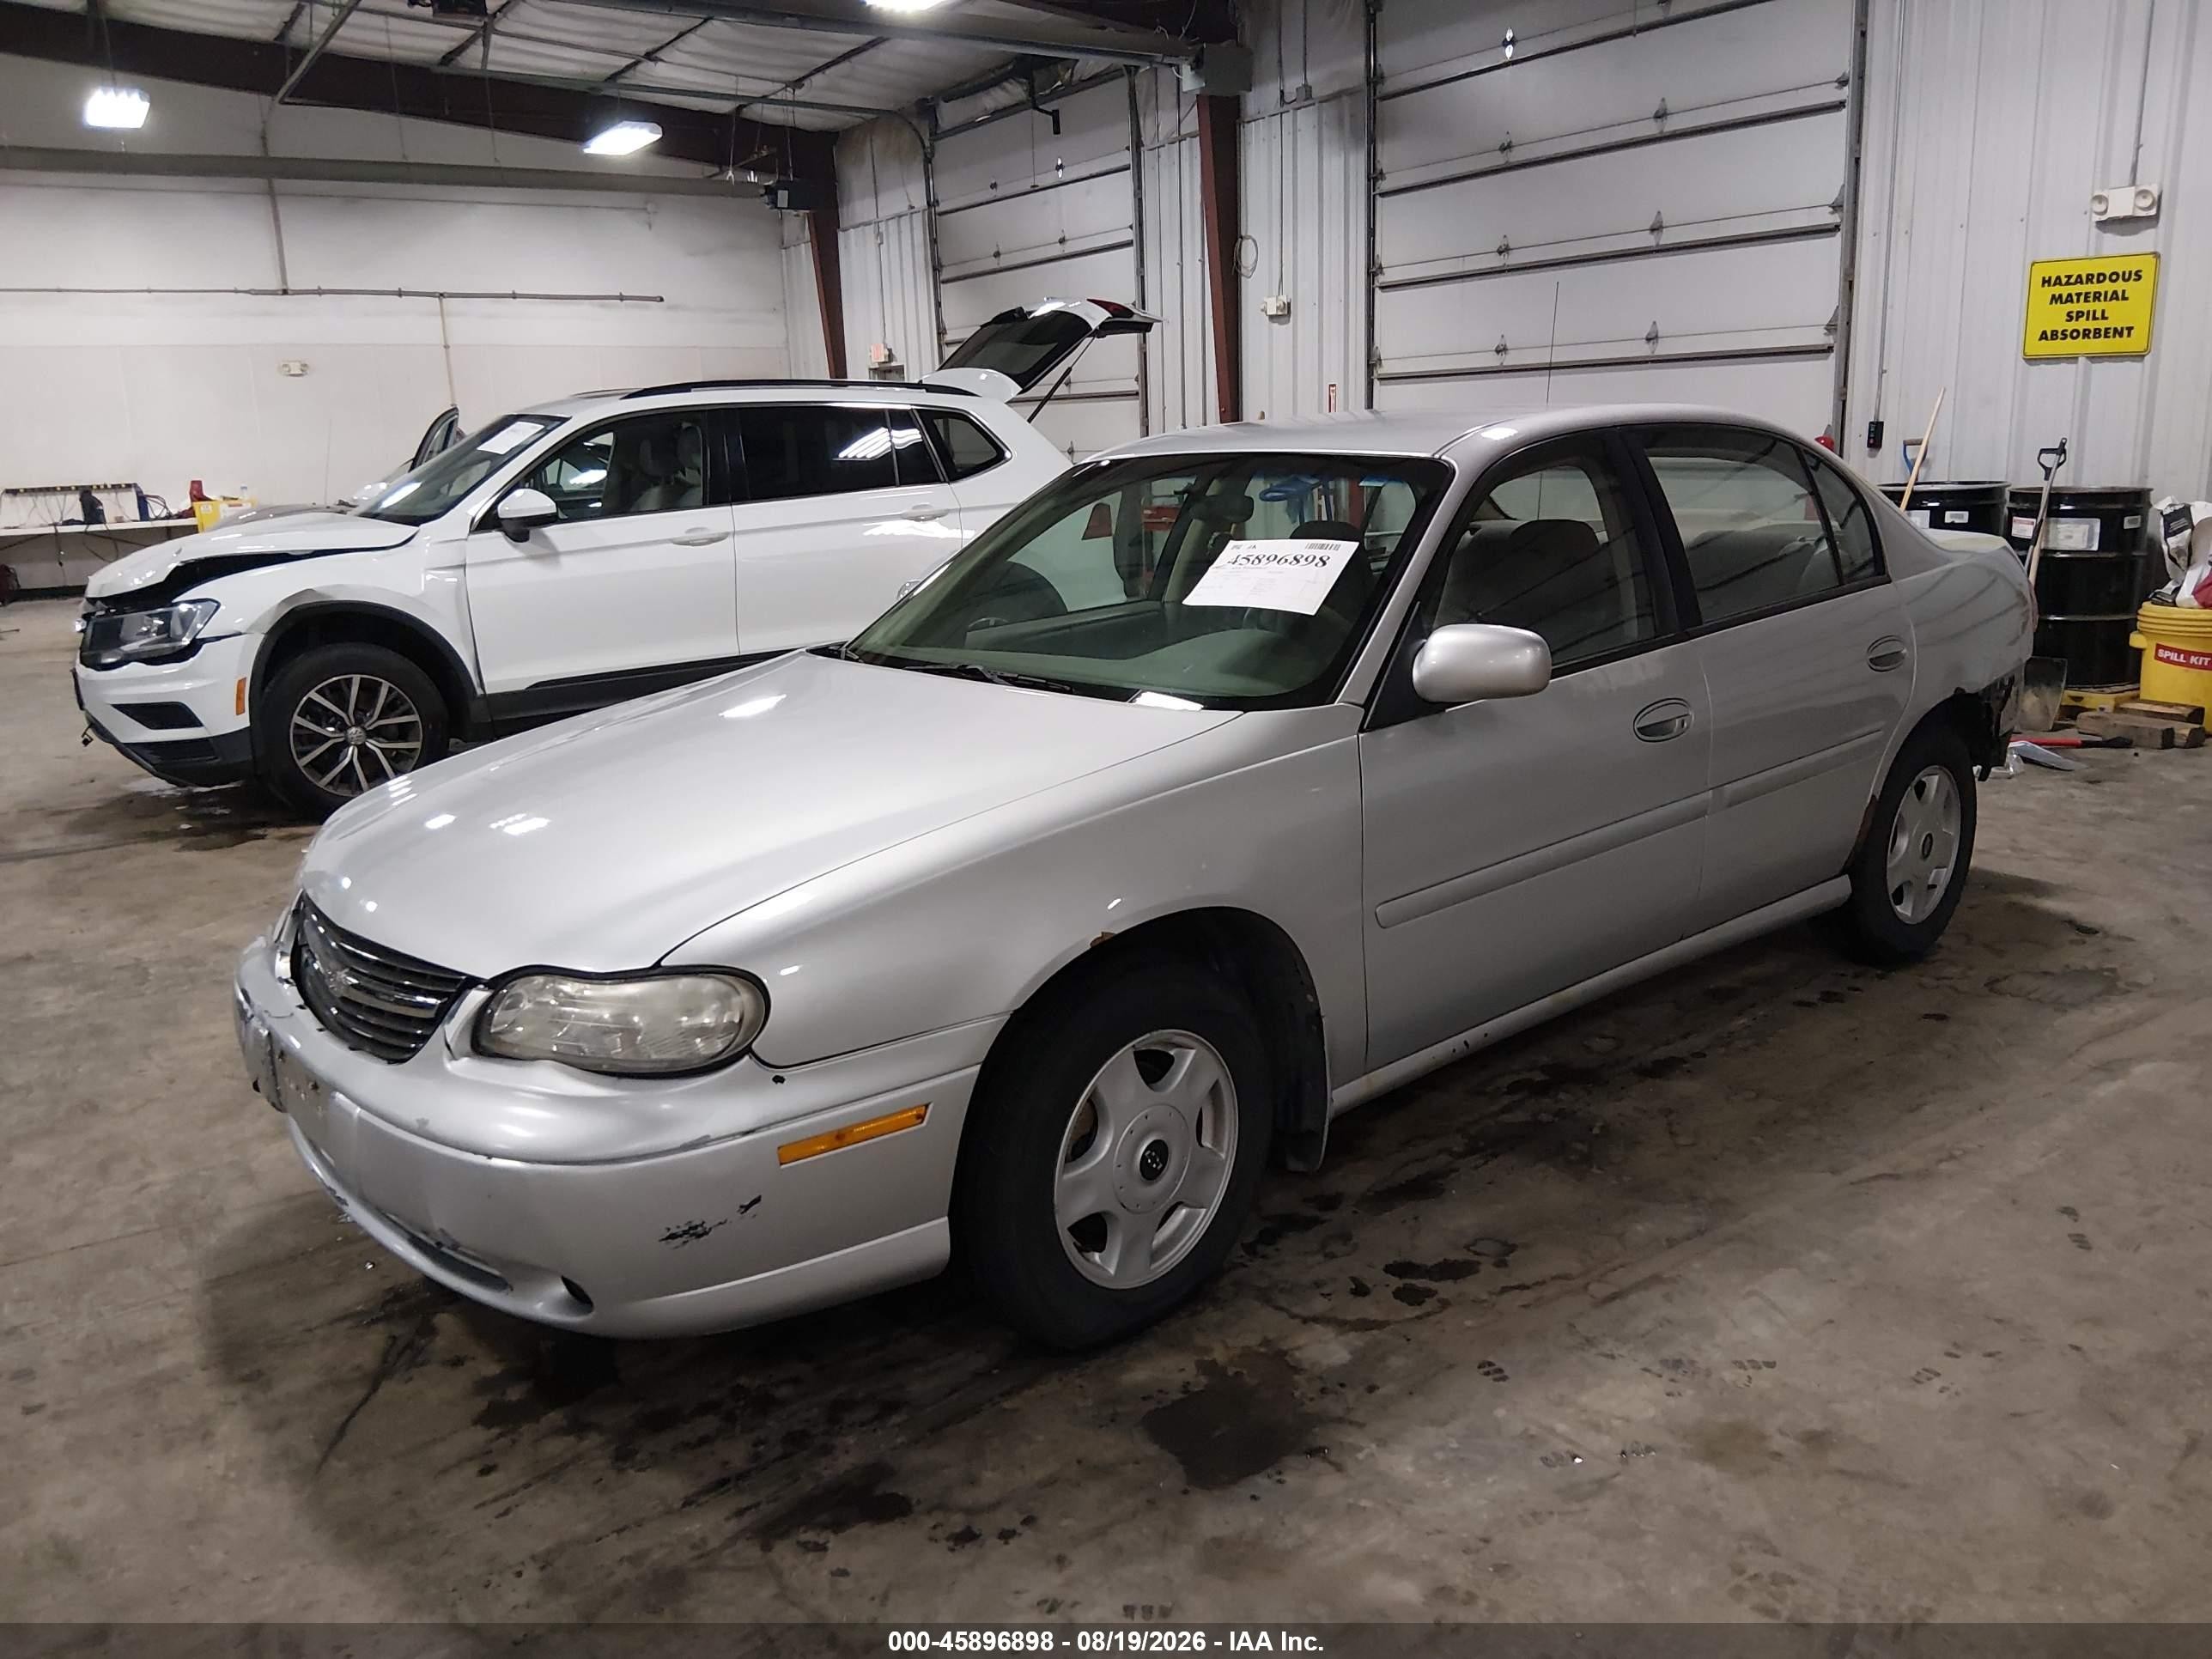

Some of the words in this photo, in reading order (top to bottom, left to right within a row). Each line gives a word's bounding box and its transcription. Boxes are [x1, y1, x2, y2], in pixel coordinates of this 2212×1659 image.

[2041, 270, 2142, 288] HAZARDOUS
[2049, 289, 2129, 305] MATERIAL
[2065, 309, 2109, 322] SPILL
[2039, 326, 2134, 341] ABSORBENT
[1227, 553, 1330, 568] 45896898
[2157, 649, 2186, 662] SPILL
[2190, 656, 2211, 665] KIT
